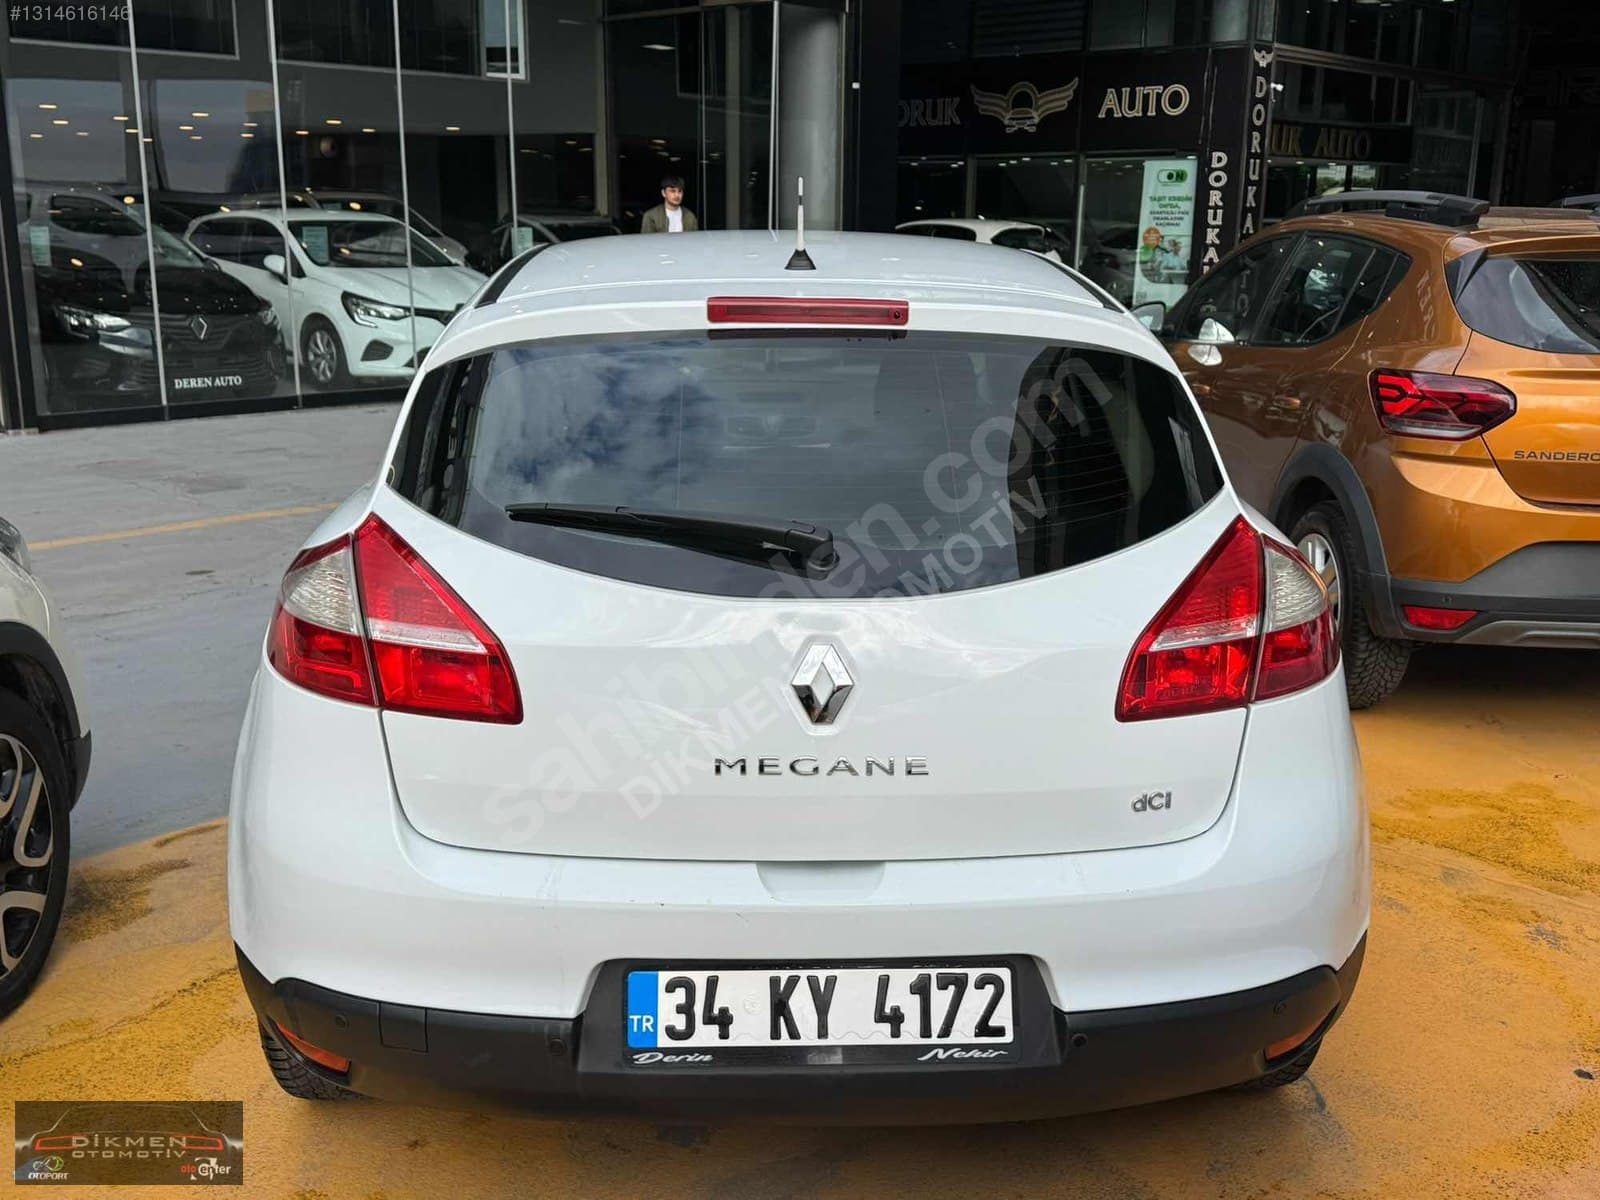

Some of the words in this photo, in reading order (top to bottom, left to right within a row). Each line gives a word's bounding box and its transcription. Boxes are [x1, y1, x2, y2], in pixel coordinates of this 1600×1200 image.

[1098, 83, 1190, 118] AUTO
[1312, 128, 1371, 160] AUTO
[1166, 171, 1185, 183] ON
[174, 376, 212, 389] DEREN
[213, 374, 243, 387] AUTO
[1514, 450, 1600, 462] SANDERO
[714, 755, 930, 777] MEGANE
[630, 1015, 654, 1033] TR
[664, 975, 734, 1041] 34
[769, 974, 838, 1040] KY
[874, 972, 1007, 1039] 4172
[632, 1051, 714, 1066] Derin
